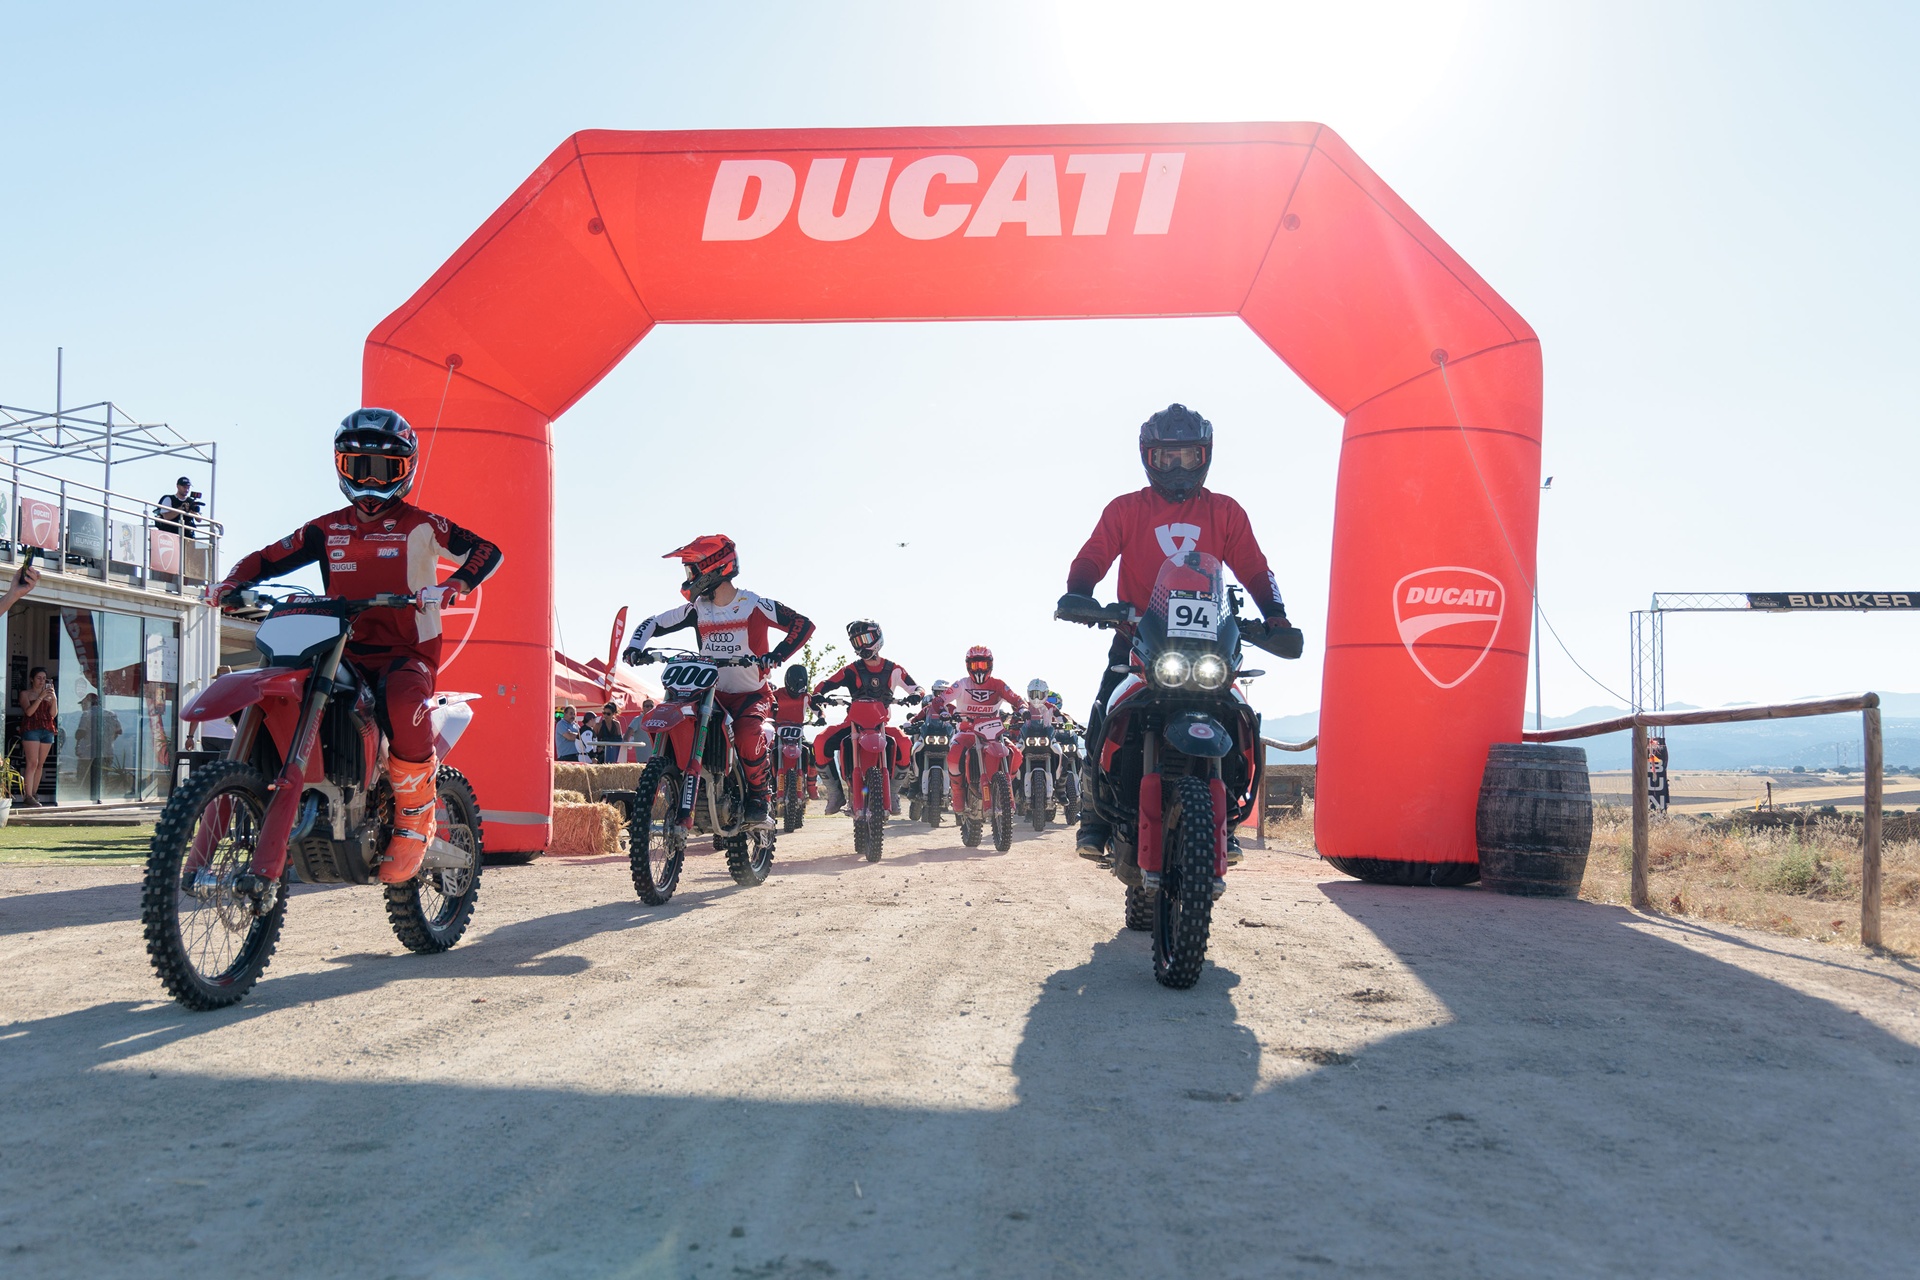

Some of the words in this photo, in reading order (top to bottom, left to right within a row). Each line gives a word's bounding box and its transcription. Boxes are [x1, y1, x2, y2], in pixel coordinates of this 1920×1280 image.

[701, 152, 1186, 241] DUCATI
[378, 547, 399, 557] 100%
[1405, 587, 1495, 607] DUCATI
[1787, 594, 1912, 607] BUNKER
[1175, 605, 1210, 628] 94
[704, 643, 742, 654] Alzaga
[662, 665, 719, 687] 900
[681, 775, 694, 810] PIRELLI
